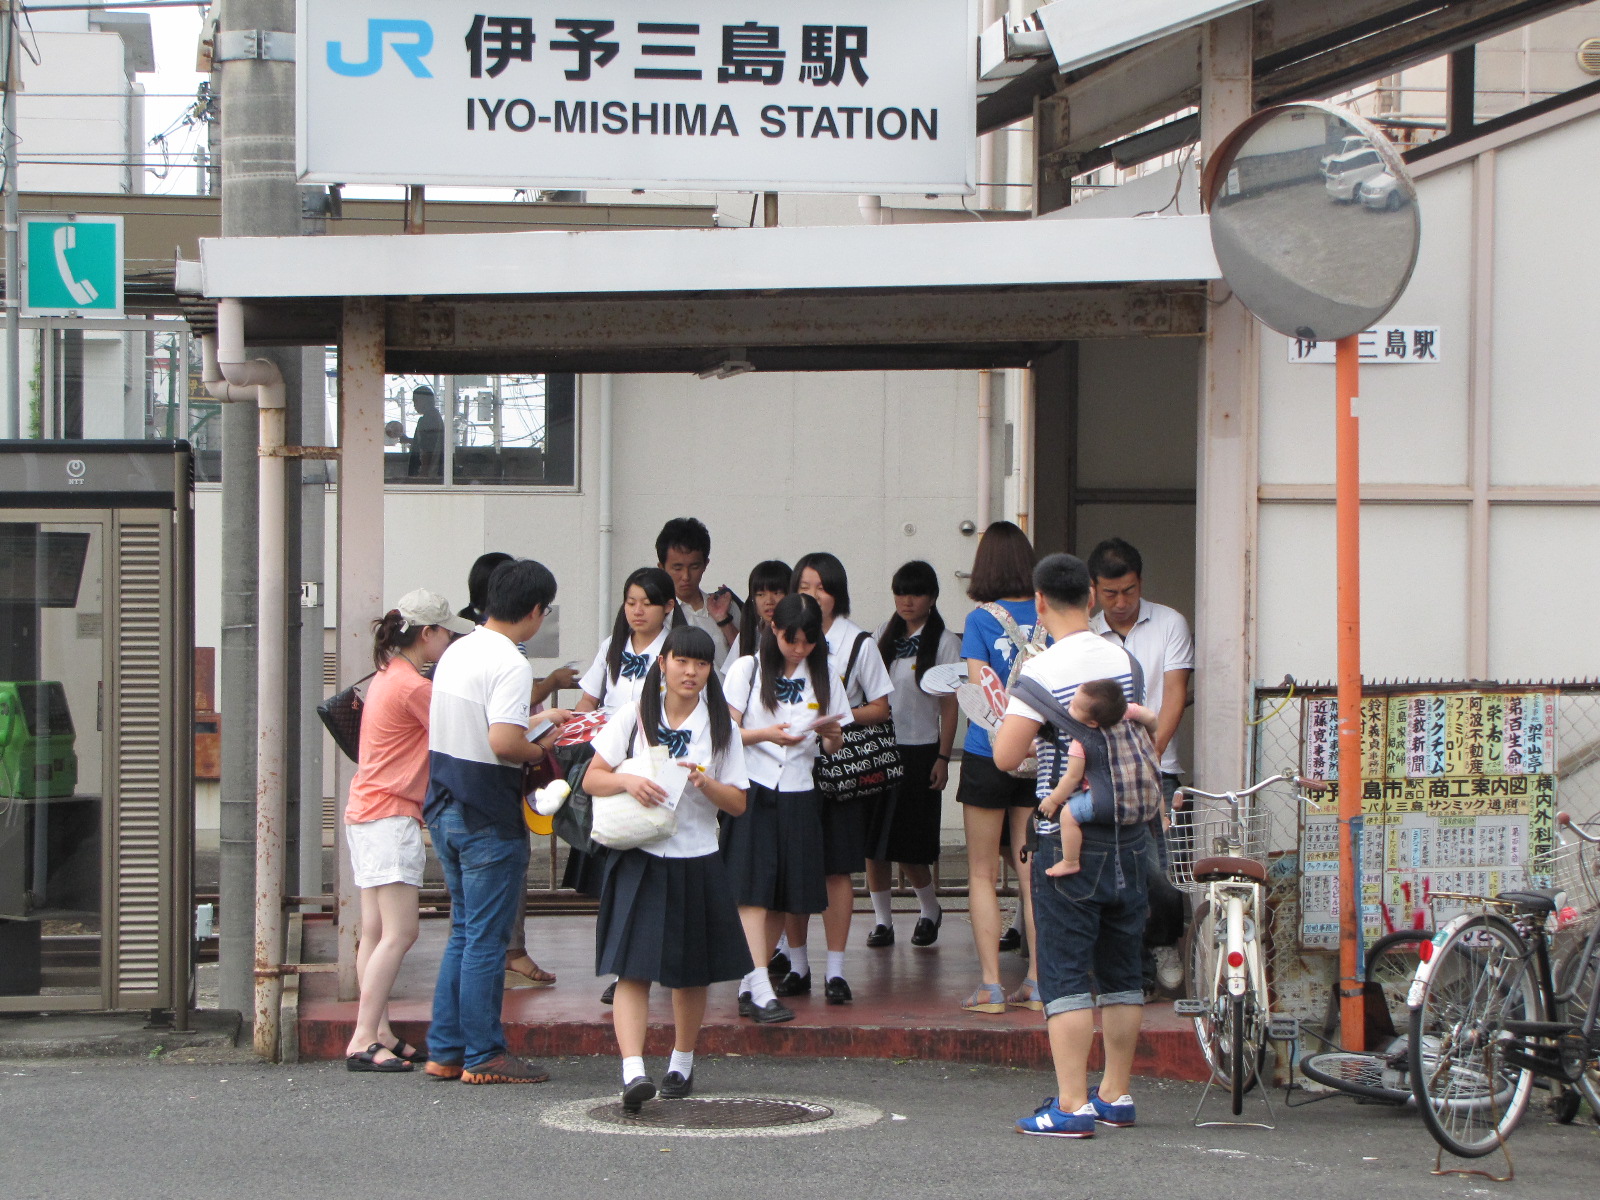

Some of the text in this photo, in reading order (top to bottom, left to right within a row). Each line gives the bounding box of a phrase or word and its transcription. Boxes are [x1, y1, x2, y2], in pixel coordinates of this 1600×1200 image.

[326, 18, 434, 78] JR
[465, 15, 868, 86] 伊予三島駅
[468, 99, 937, 140] IYO-MISHIMA STATION
[1295, 329, 1435, 359] 伊三島駅
[1411, 698, 1426, 773] 聖教新聞
[1446, 740, 1454, 773] ローン
[1455, 697, 1464, 761] ファミリー
[1468, 696, 1484, 774] 阿波不動産
[1508, 696, 1522, 766] 第百生命
[1307, 779, 1403, 803] 伊予島市
[1429, 776, 1528, 799] 商工案内図
[1534, 775, 1553, 874] 横内外科医院
